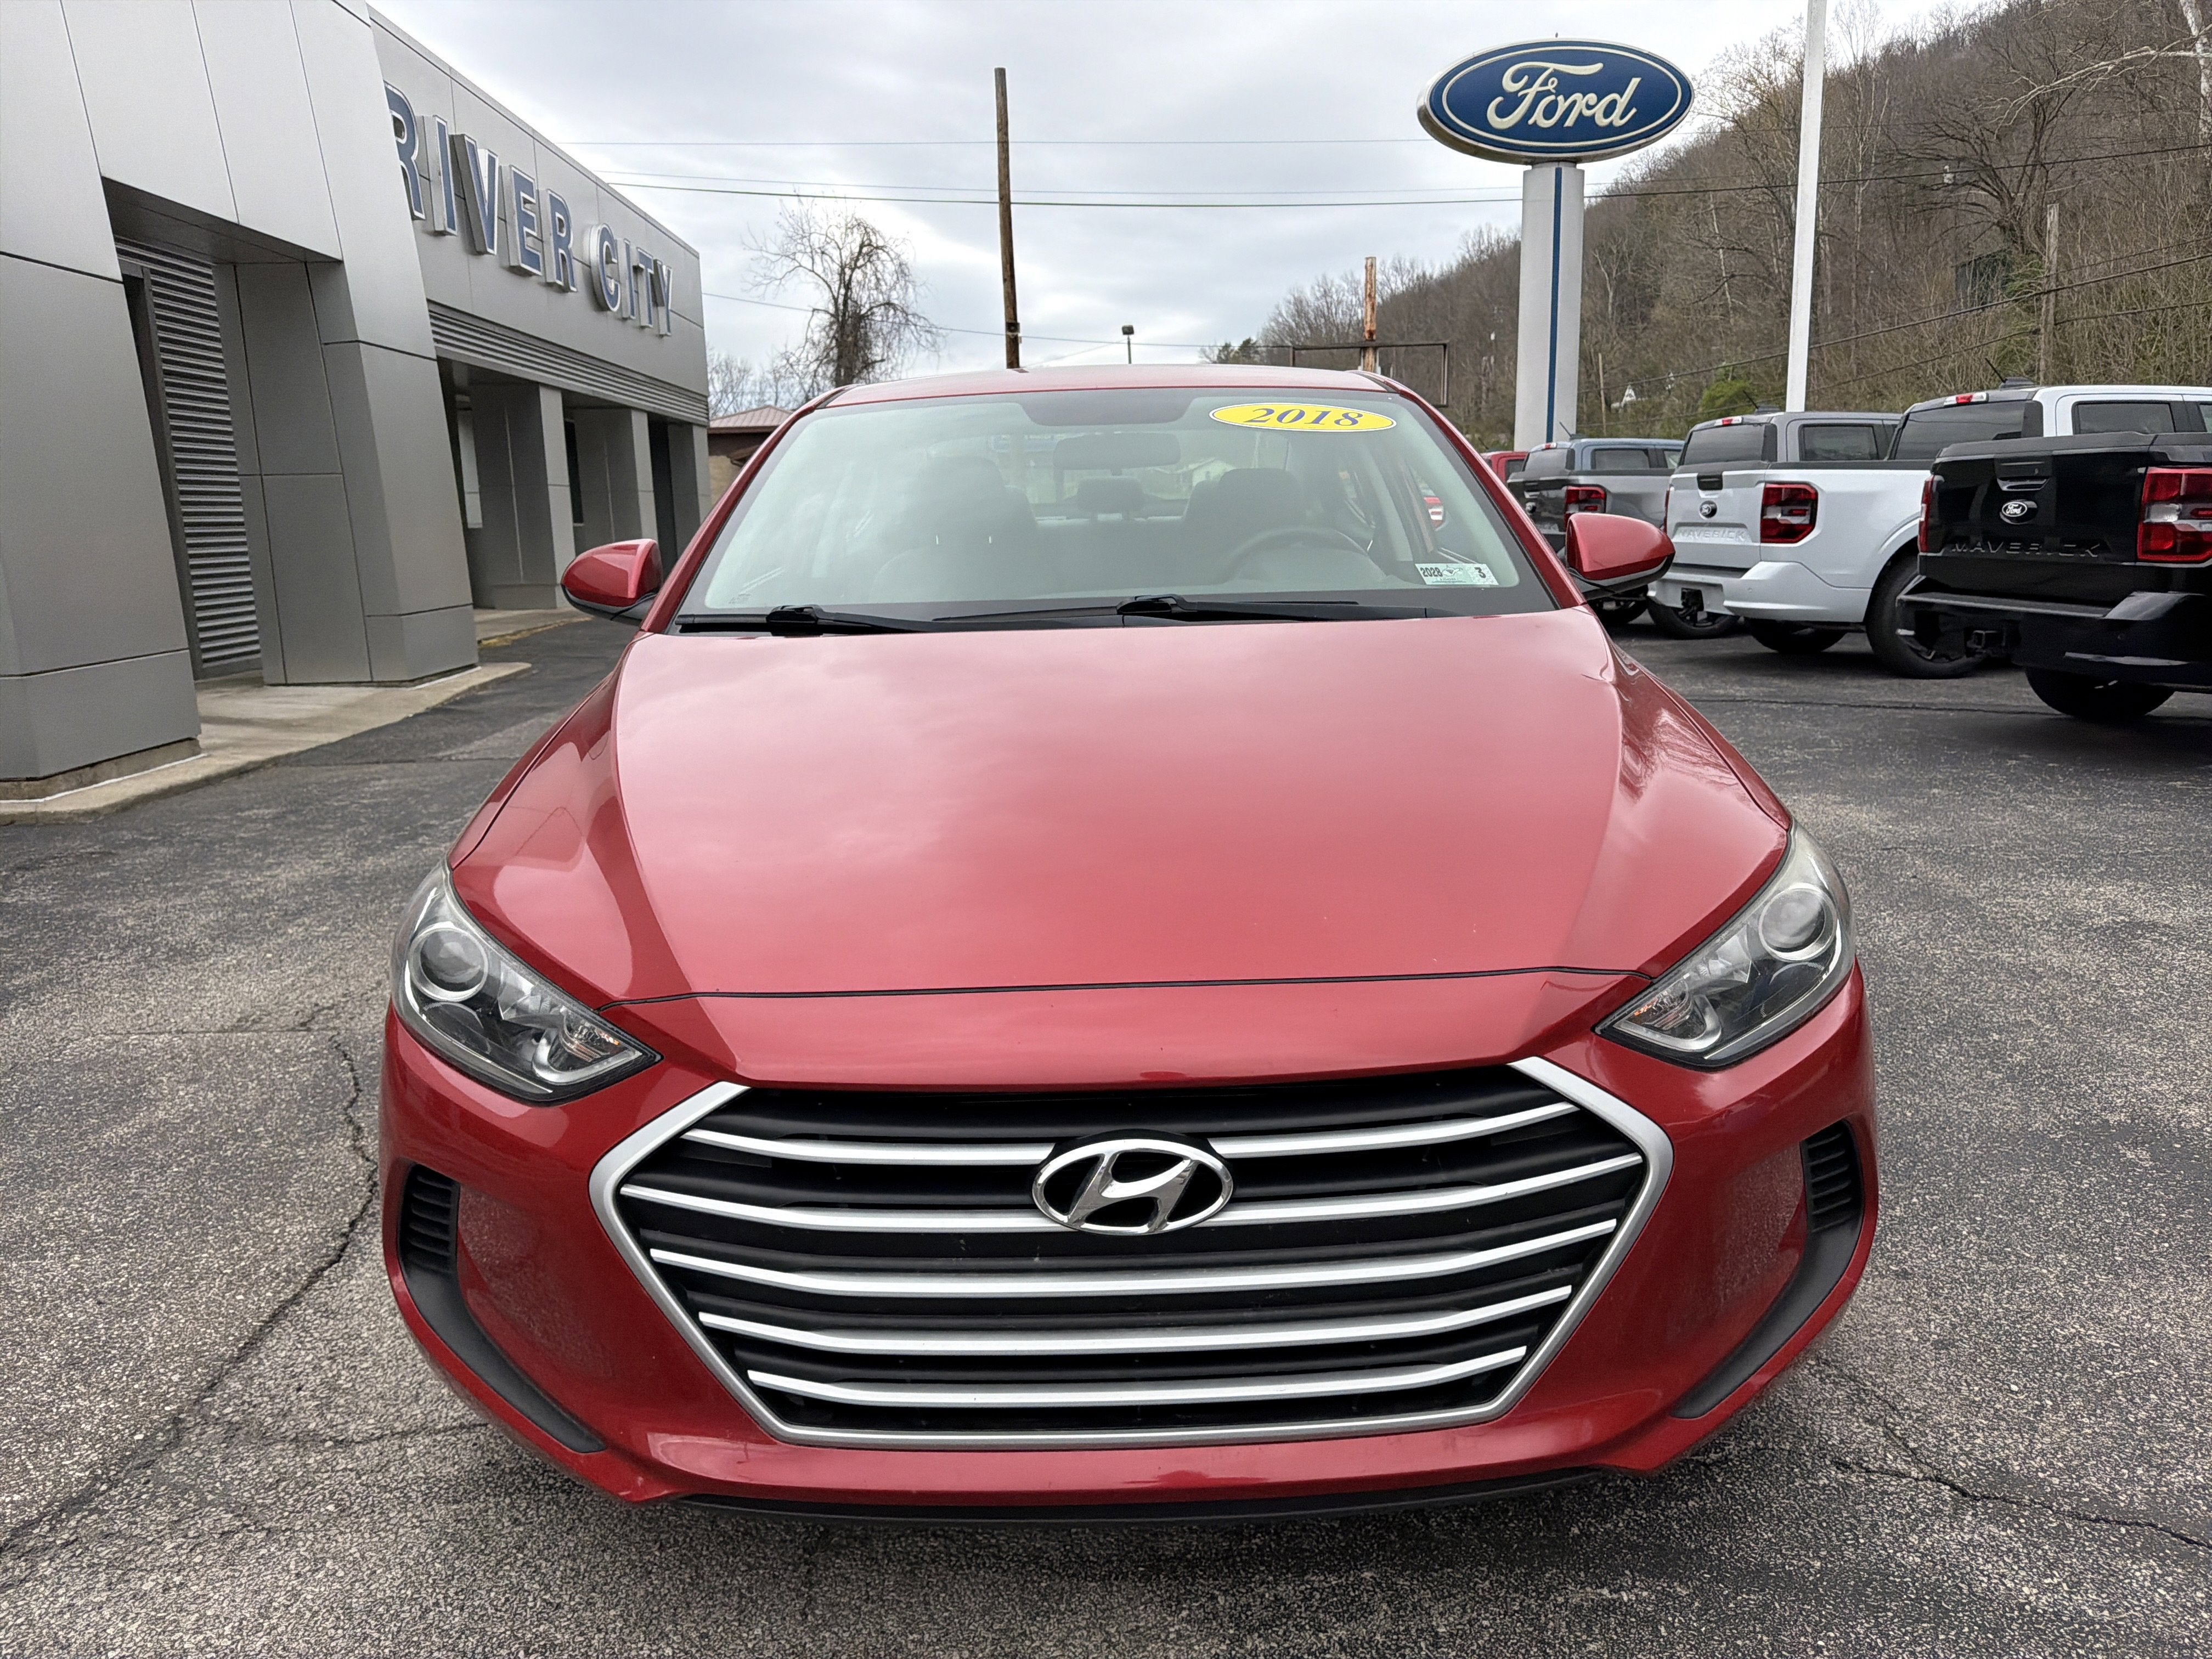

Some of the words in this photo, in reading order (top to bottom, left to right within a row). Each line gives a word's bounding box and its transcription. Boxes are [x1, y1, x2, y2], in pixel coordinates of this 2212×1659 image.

[1487, 61, 1642, 129] Ford
[383, 80, 577, 292] RIVER
[589, 224, 673, 336] CITY
[1243, 408, 1363, 426] 2018
[2006, 504, 2022, 514] Ford
[1679, 529, 1746, 541] MAVERICK
[1420, 567, 1443, 577] 2028
[1474, 567, 1486, 578] 3
